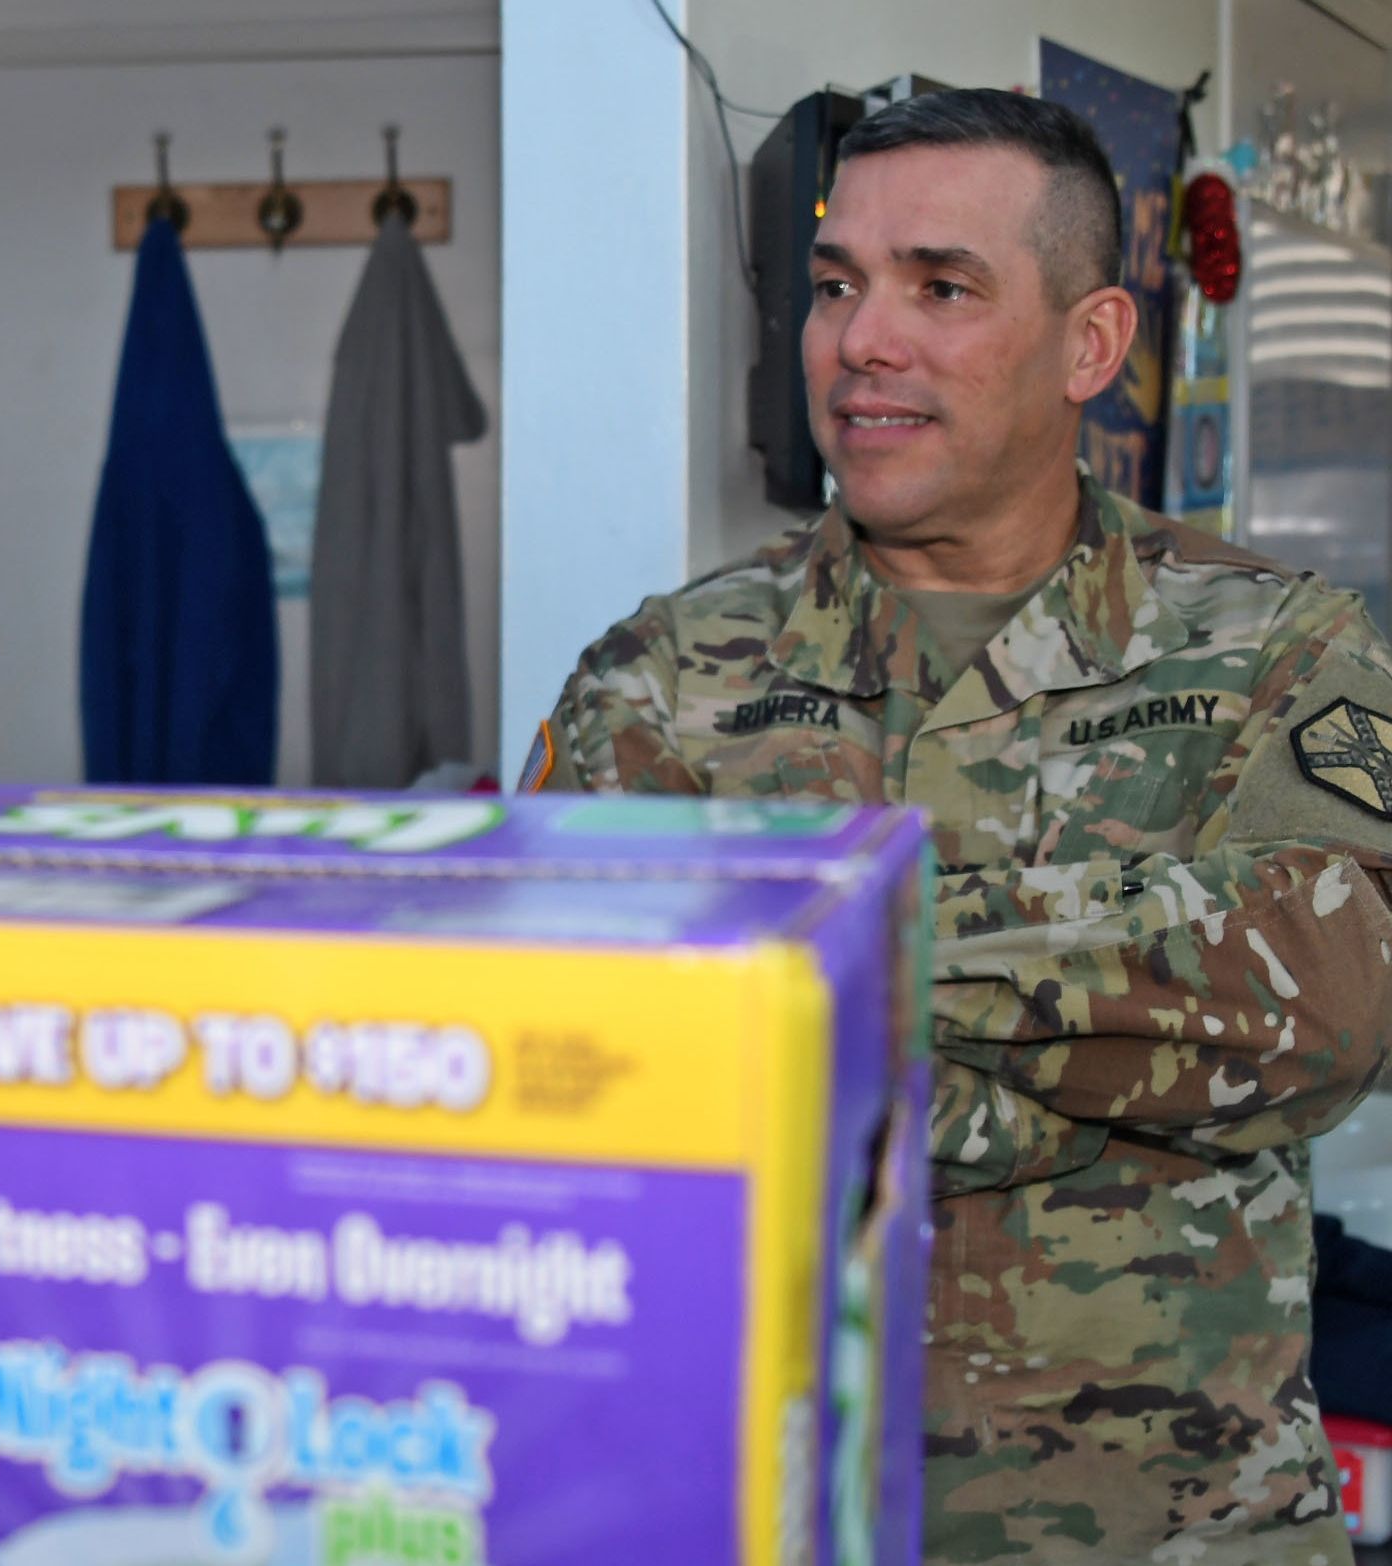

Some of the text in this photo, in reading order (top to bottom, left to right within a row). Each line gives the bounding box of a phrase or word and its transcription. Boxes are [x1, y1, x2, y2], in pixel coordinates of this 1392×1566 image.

[734, 694, 841, 732] RIVERA
[82, 1008, 187, 1090] UP
[194, 1014, 298, 1099] TO
[187, 1205, 327, 1298] Even
[335, 1213, 632, 1344] Overnight
[284, 1362, 490, 1494] Lock
[324, 1480, 468, 1566] plus
